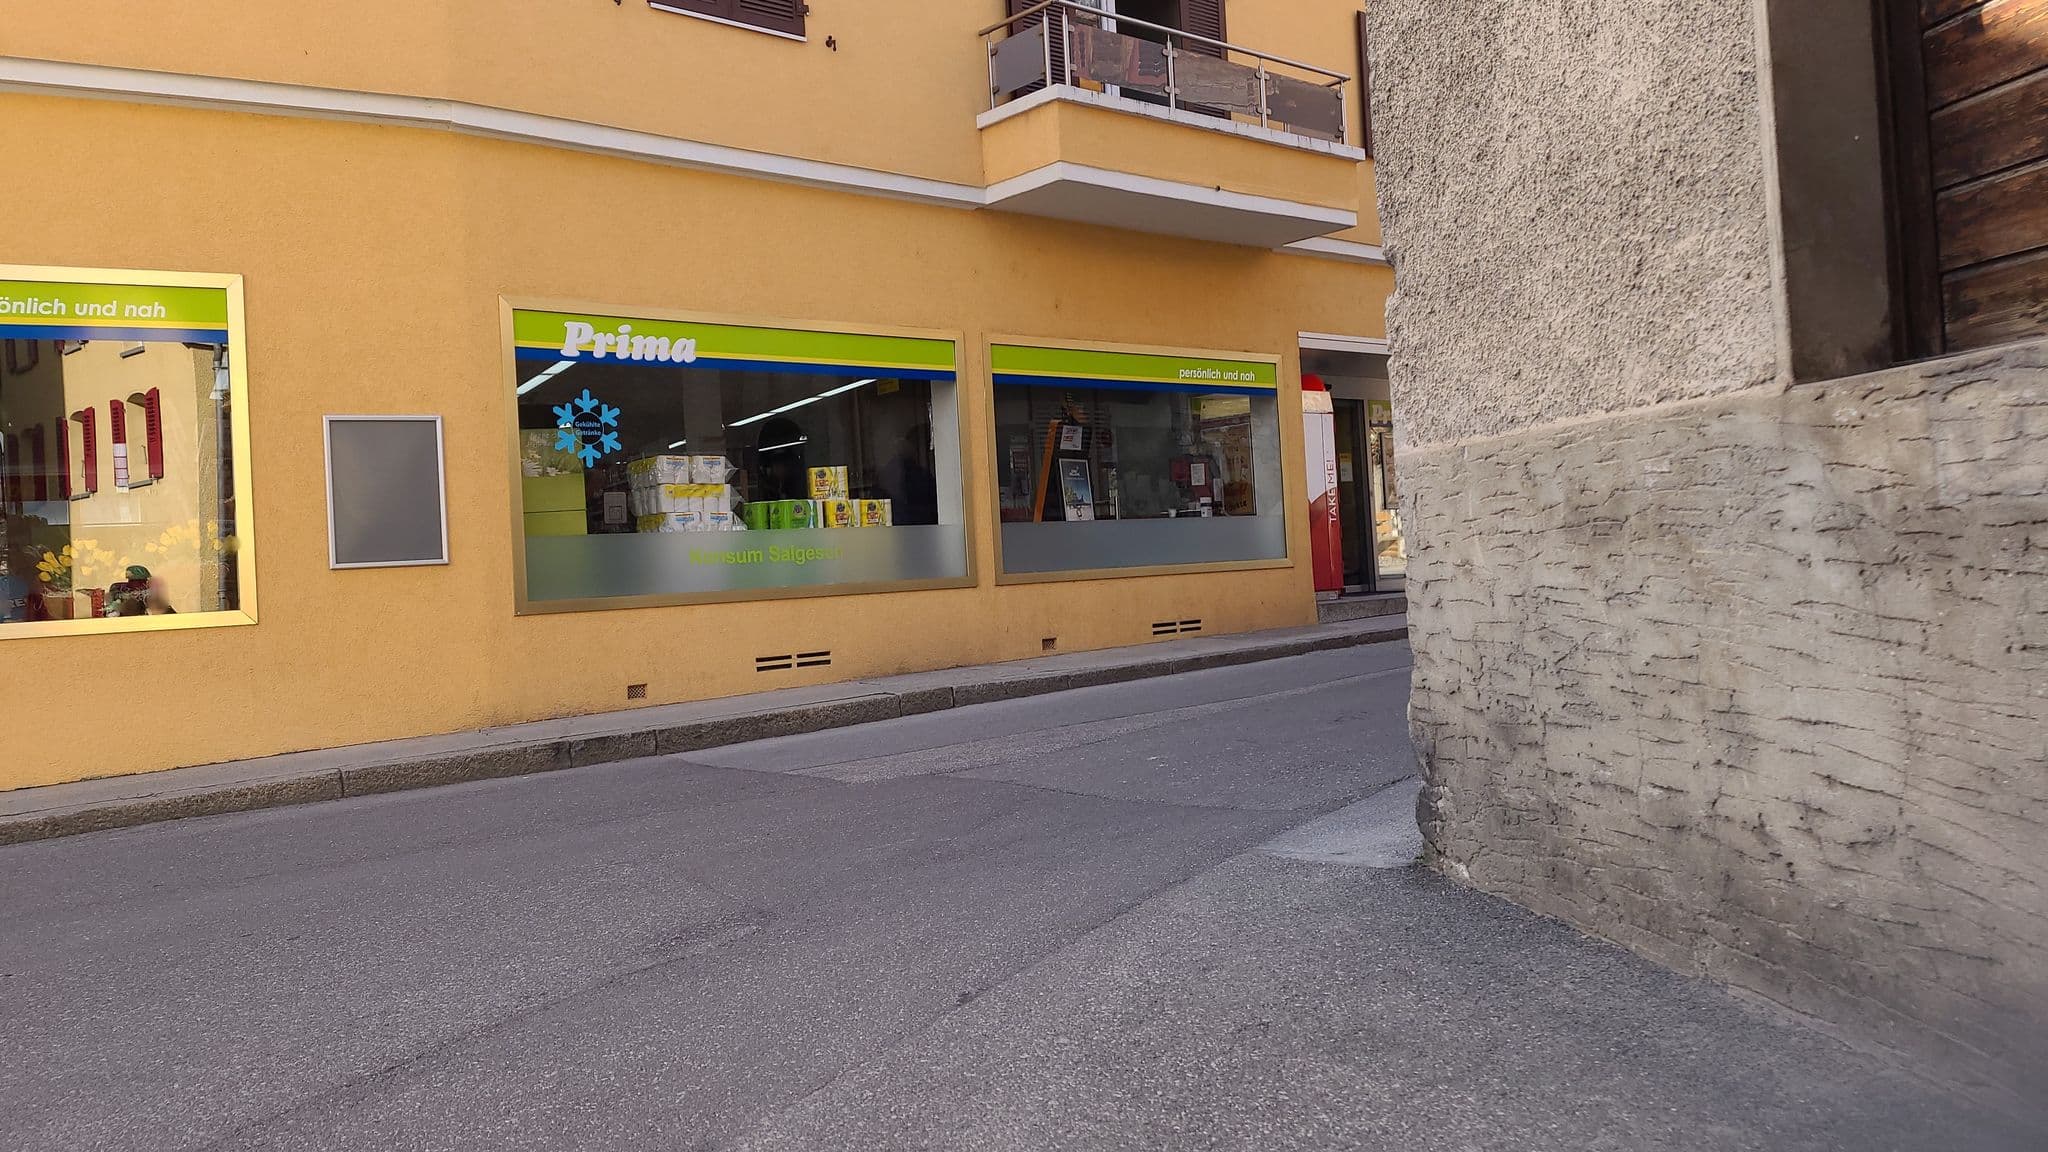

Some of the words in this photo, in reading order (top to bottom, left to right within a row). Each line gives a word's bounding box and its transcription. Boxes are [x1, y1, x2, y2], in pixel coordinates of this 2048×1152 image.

[0, 297, 66, 315] önlich
[75, 300, 117, 316] und
[124, 302, 166, 318] nah
[560, 321, 697, 363] Prima
[1179, 367, 1220, 380] persönlich
[1223, 370, 1239, 381] und
[1240, 371, 1255, 381] nah
[574, 420, 601, 428] Gekühlte
[575, 429, 602, 437] Getränke
[1325, 459, 1336, 485] ME!
[1326, 487, 1339, 524] TAKE
